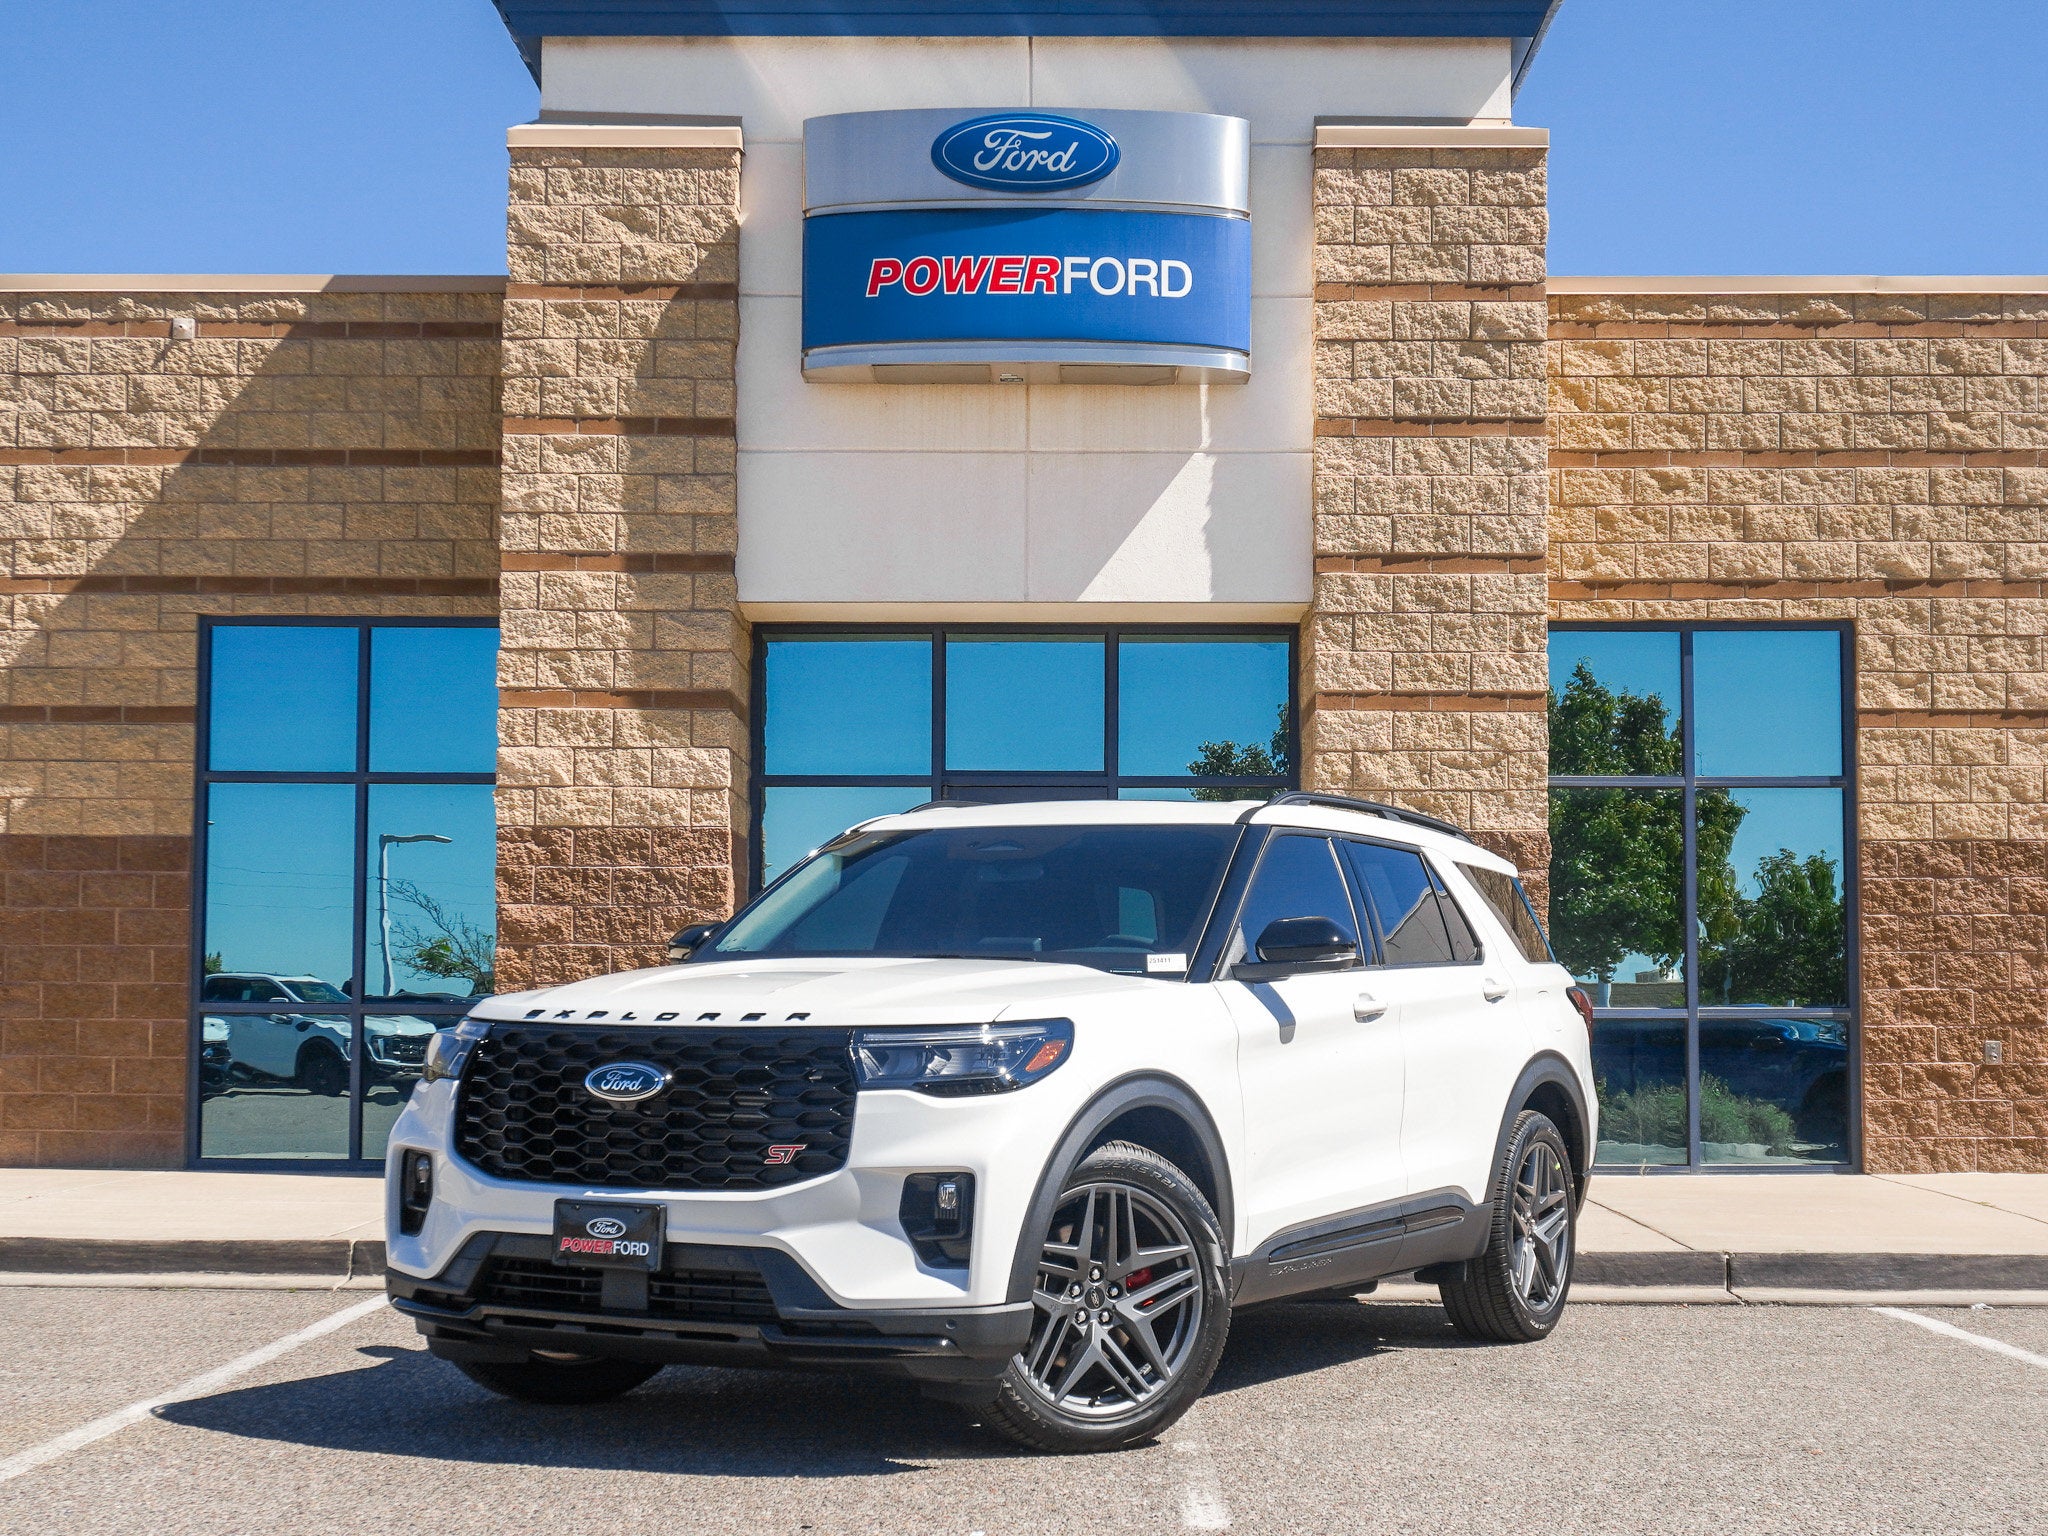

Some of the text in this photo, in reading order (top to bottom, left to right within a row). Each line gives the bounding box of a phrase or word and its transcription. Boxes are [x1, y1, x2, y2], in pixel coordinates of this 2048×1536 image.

[973, 128, 1079, 173] Ford
[865, 255, 1193, 298] POWERFORD
[523, 1009, 811, 1022] EXPLORER
[600, 1070, 642, 1092] Ford
[764, 1144, 807, 1164] ST
[593, 1221, 618, 1235] Ford
[560, 1237, 650, 1257] POWERFORD
